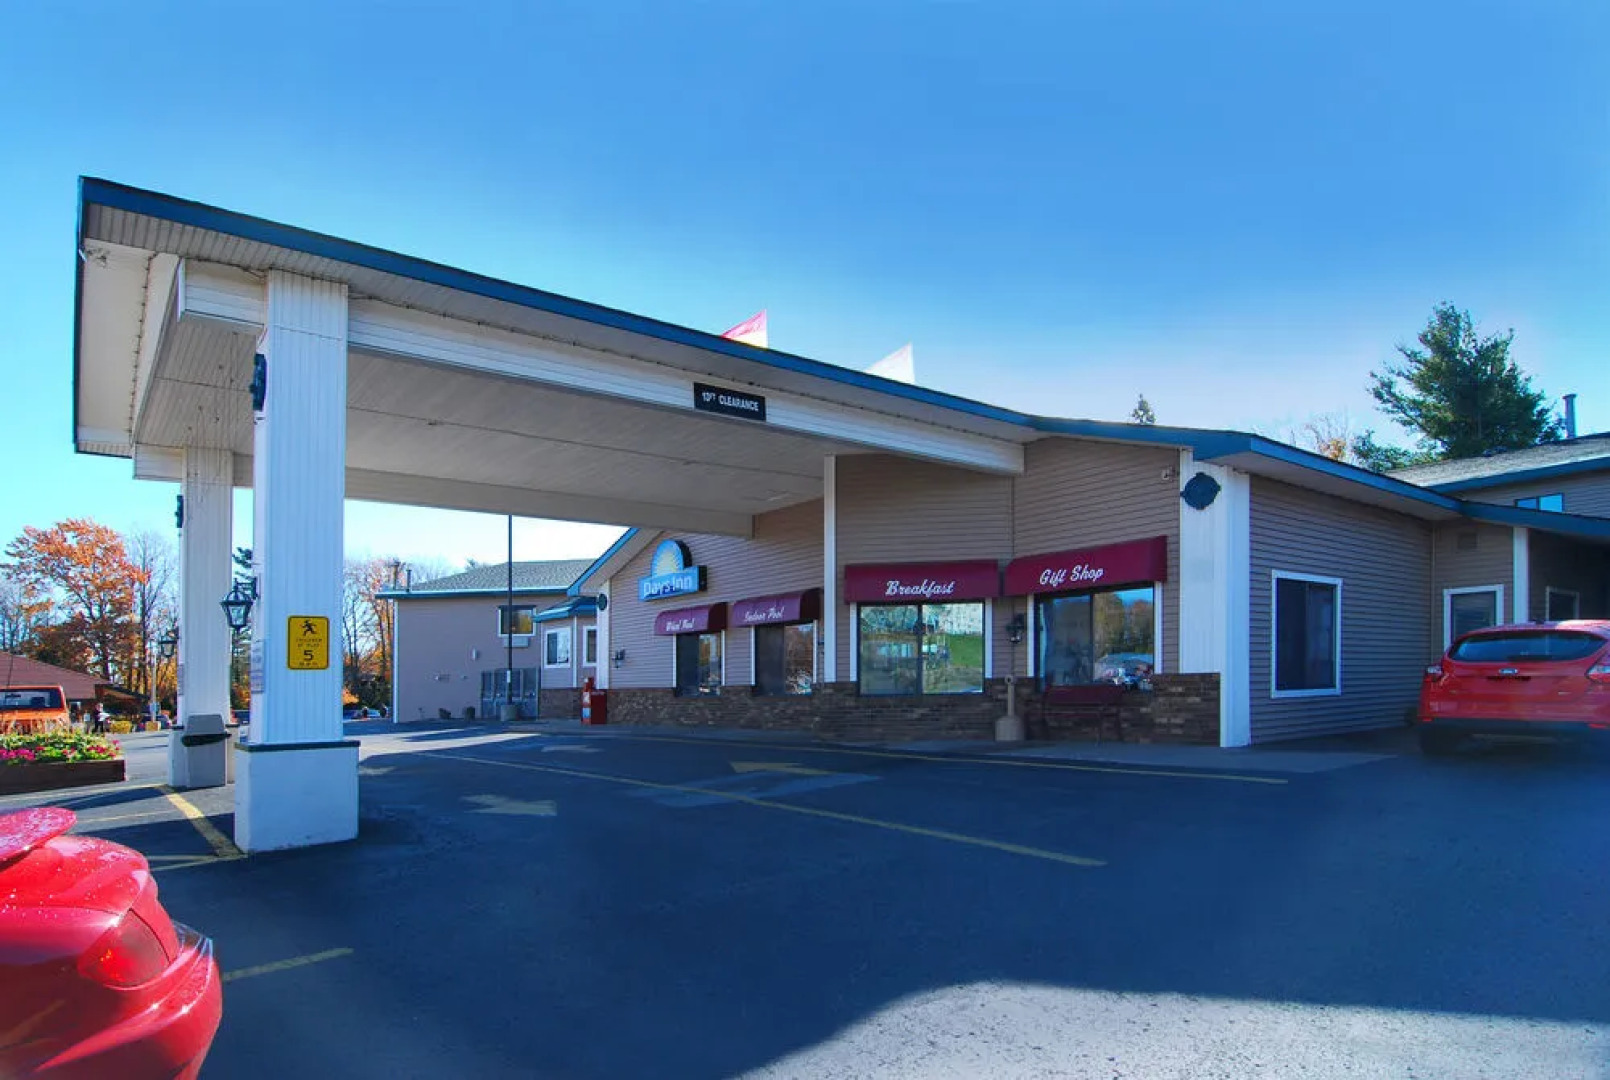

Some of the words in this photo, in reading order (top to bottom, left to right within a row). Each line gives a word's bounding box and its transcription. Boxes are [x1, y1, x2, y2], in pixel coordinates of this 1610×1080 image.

[718, 395, 759, 411] CLEARANCE
[672, 575, 692, 592] Inn
[1040, 569, 1067, 587] Gift
[1070, 563, 1104, 582] Shop
[885, 579, 955, 597] Breakfast
[303, 649, 314, 661] 5
